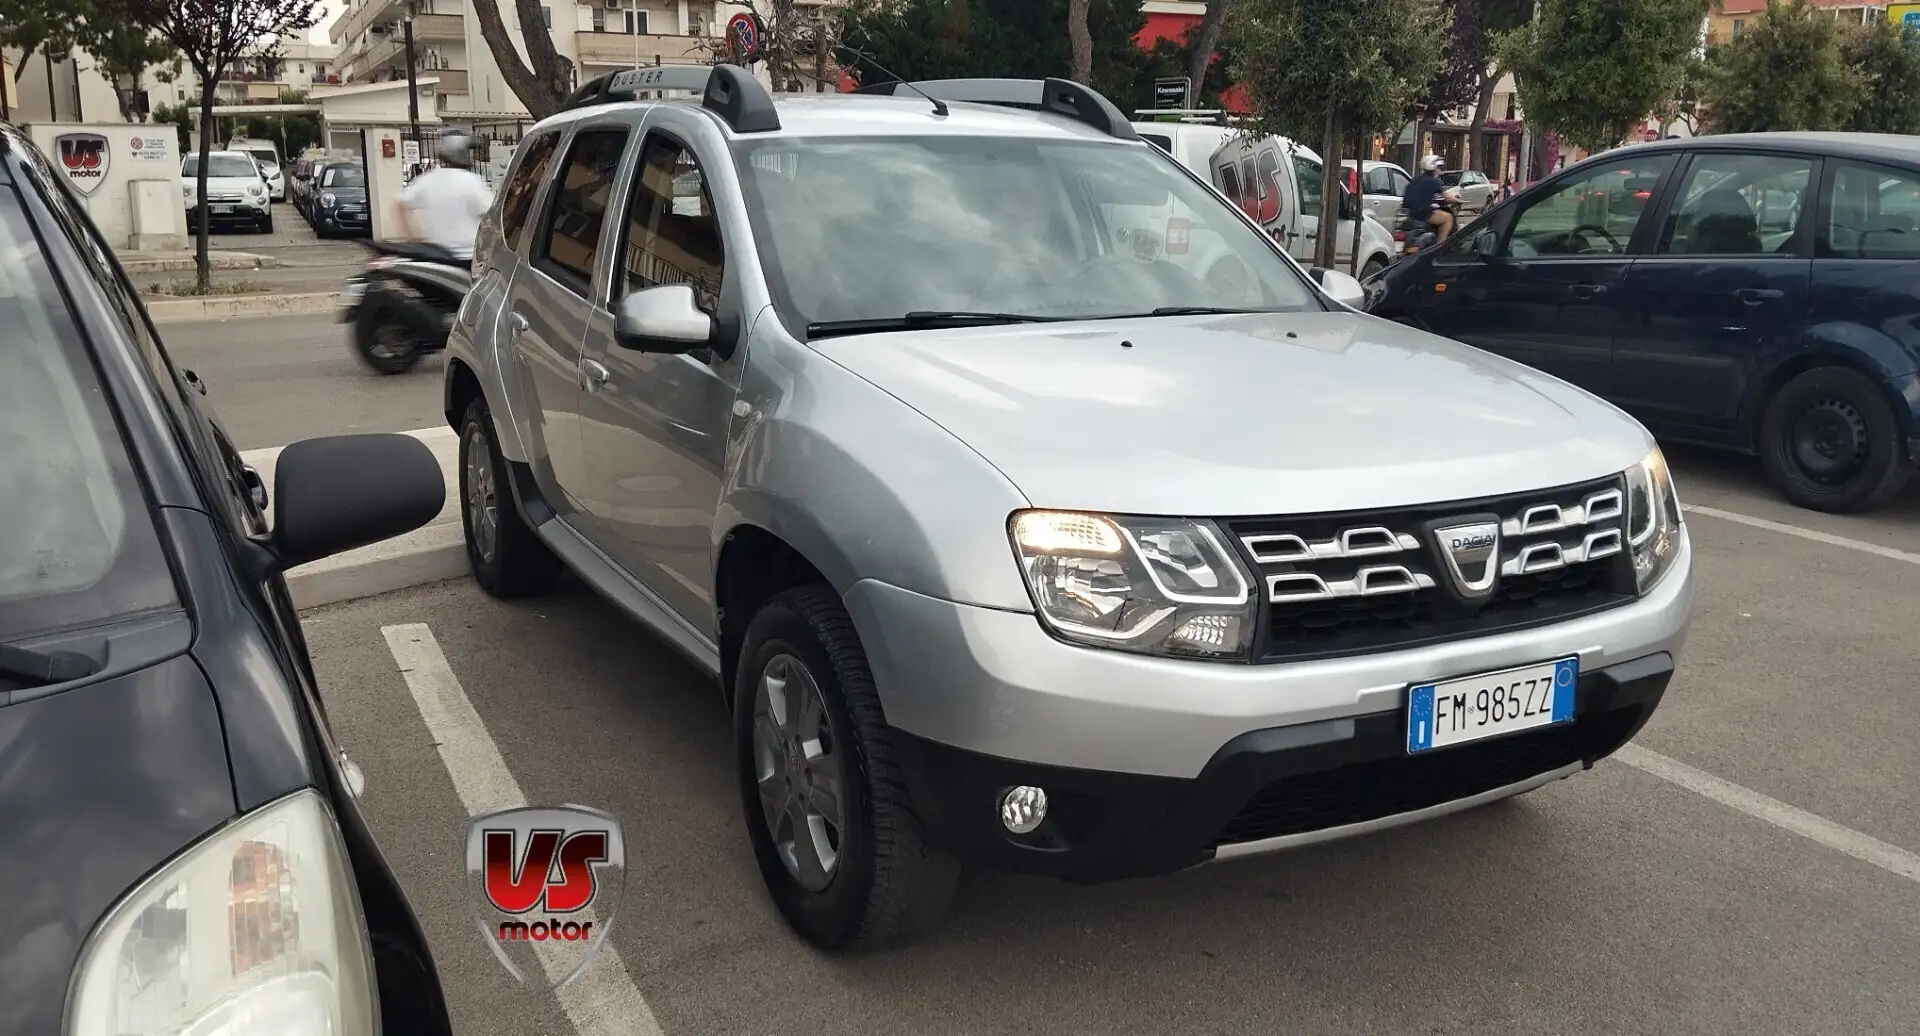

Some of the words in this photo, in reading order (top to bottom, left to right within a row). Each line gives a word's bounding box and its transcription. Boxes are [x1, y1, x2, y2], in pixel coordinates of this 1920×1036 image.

[613, 71, 663, 87] DUSTER
[70, 169, 101, 178] motor
[1452, 534, 1496, 548] DACIA
[1435, 692, 1467, 735] FM
[1476, 676, 1553, 726] 985ZZ
